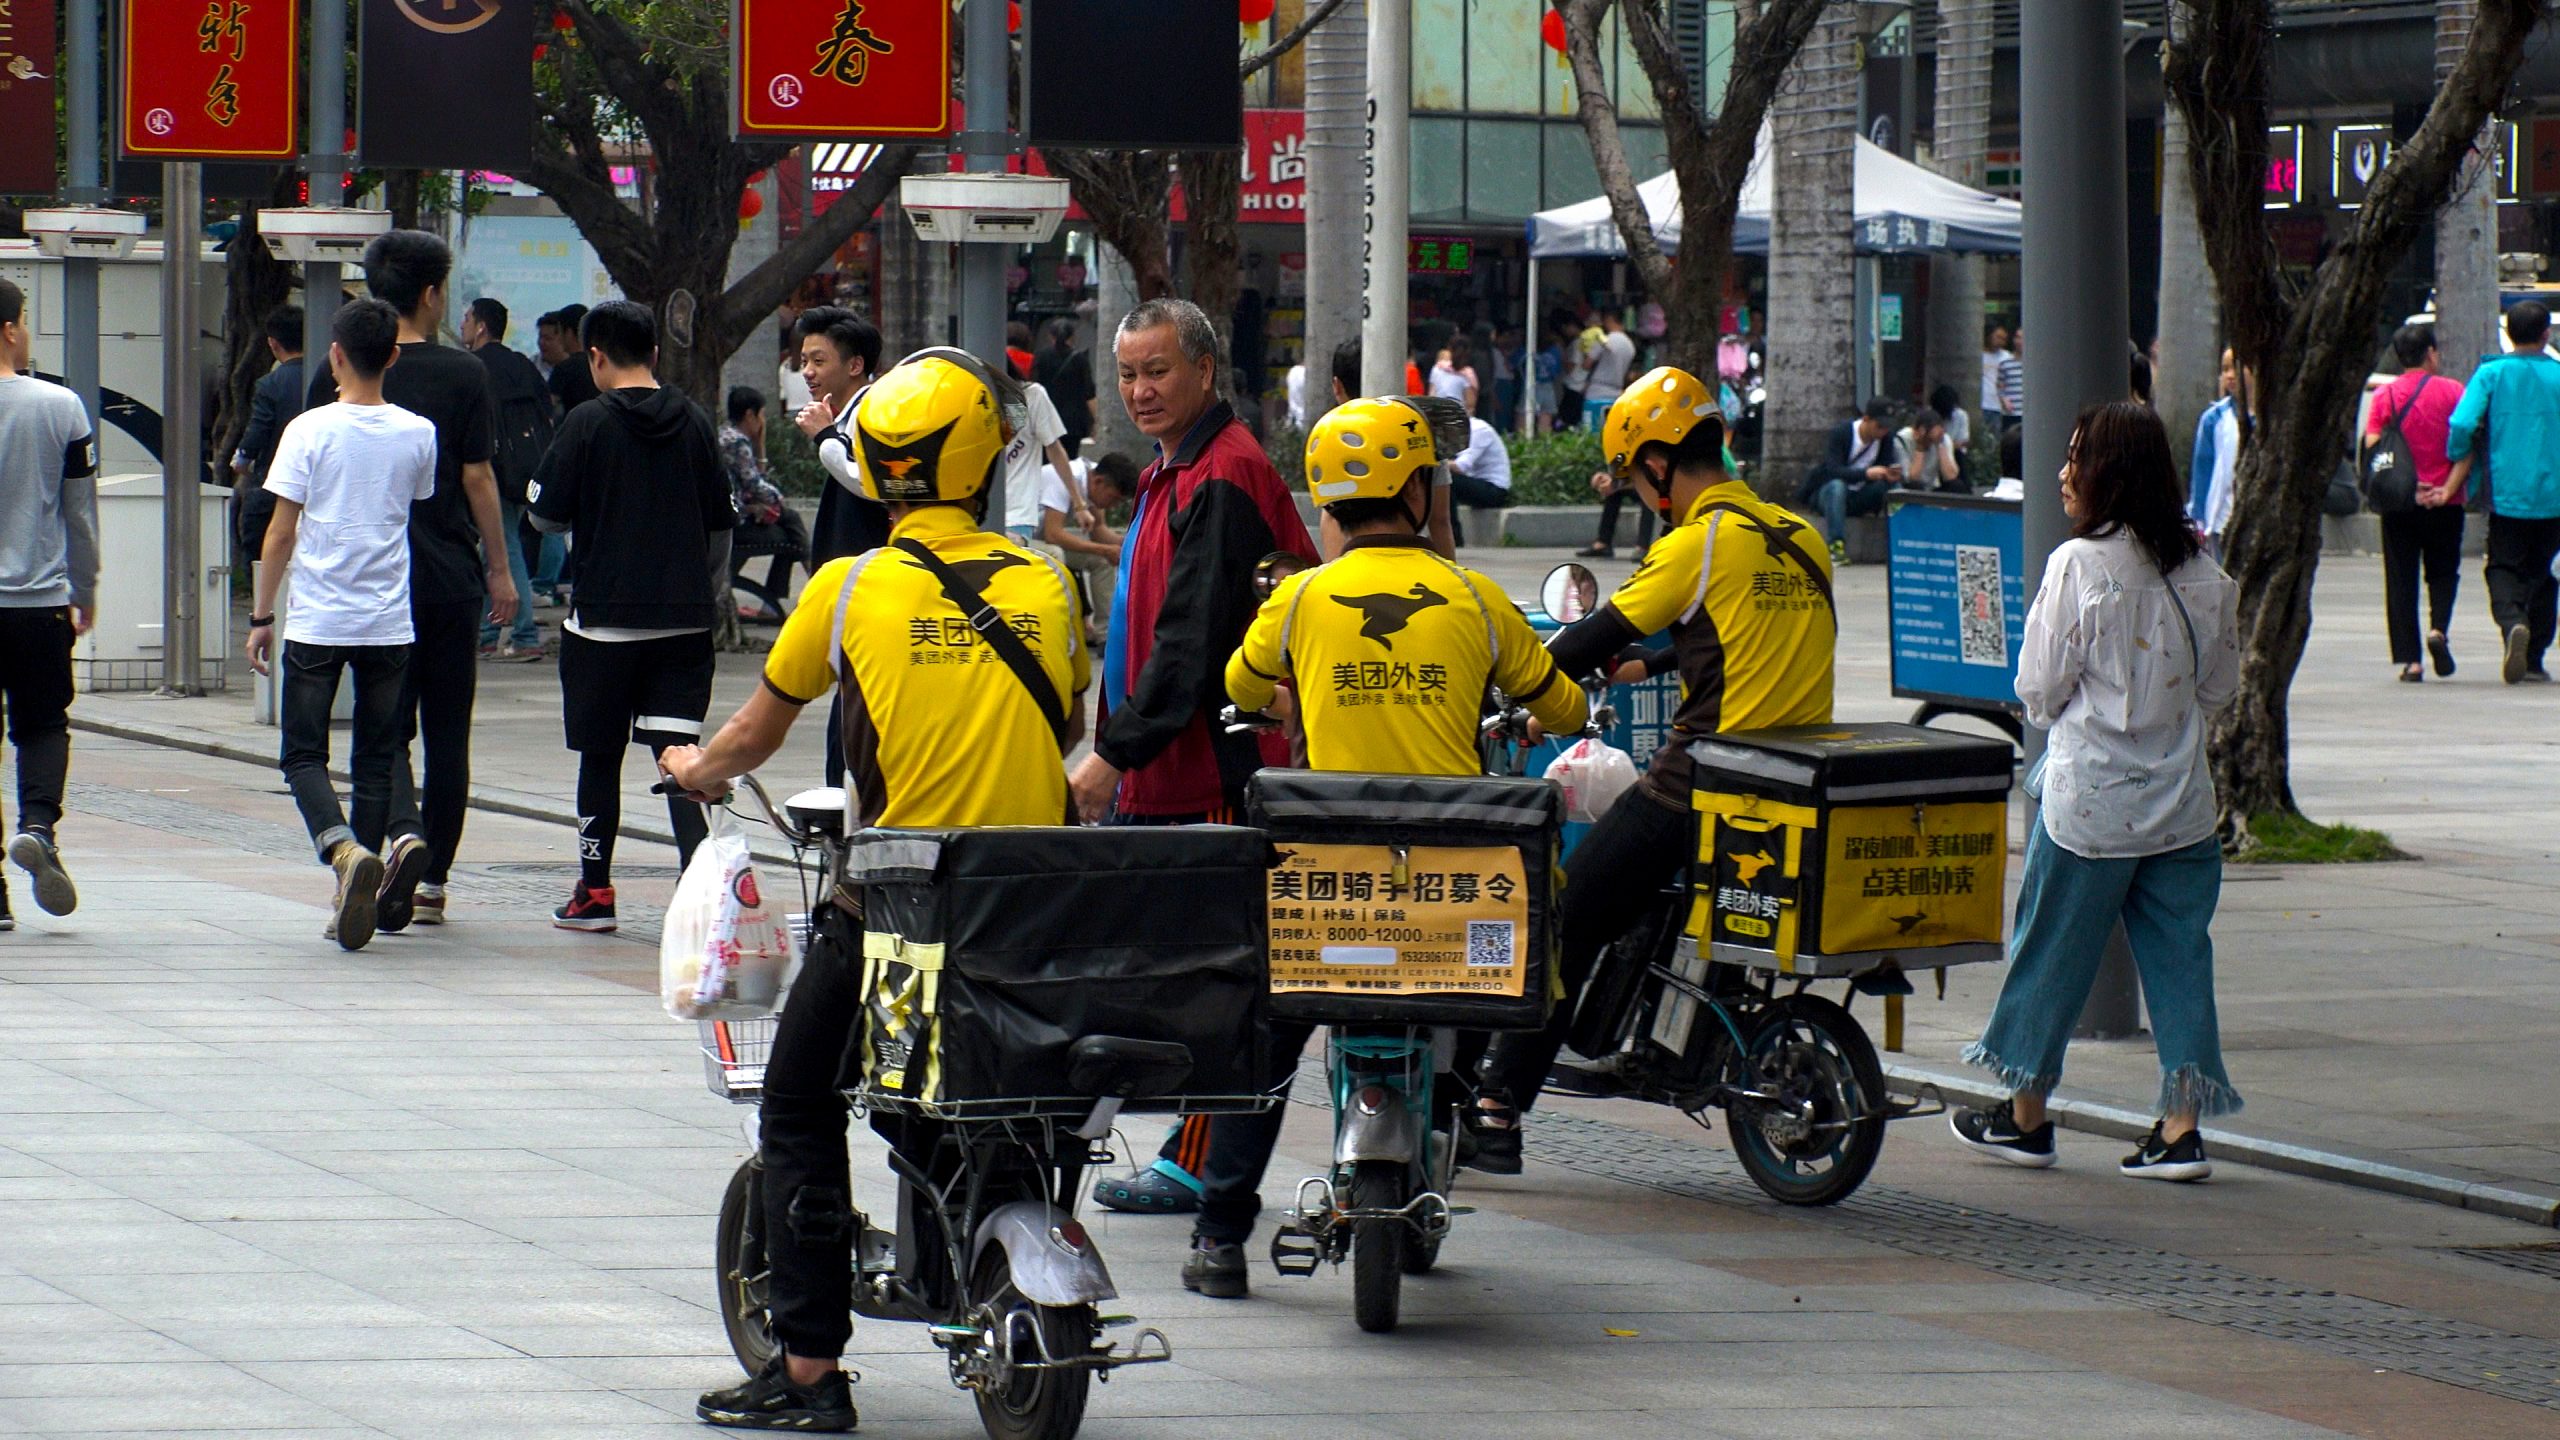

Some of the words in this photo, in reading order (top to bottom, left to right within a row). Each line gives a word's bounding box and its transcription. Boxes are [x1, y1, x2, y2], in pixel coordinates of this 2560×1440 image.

[810, 0, 895, 87] 春
[909, 612, 1043, 647] 美团卖
[1332, 662, 1448, 692] 美团外卖
[1271, 870, 1516, 903] 美团骑手招募令
[1717, 887, 1779, 918] 美团外卖
[1327, 928, 1422, 942] 8000-12000
